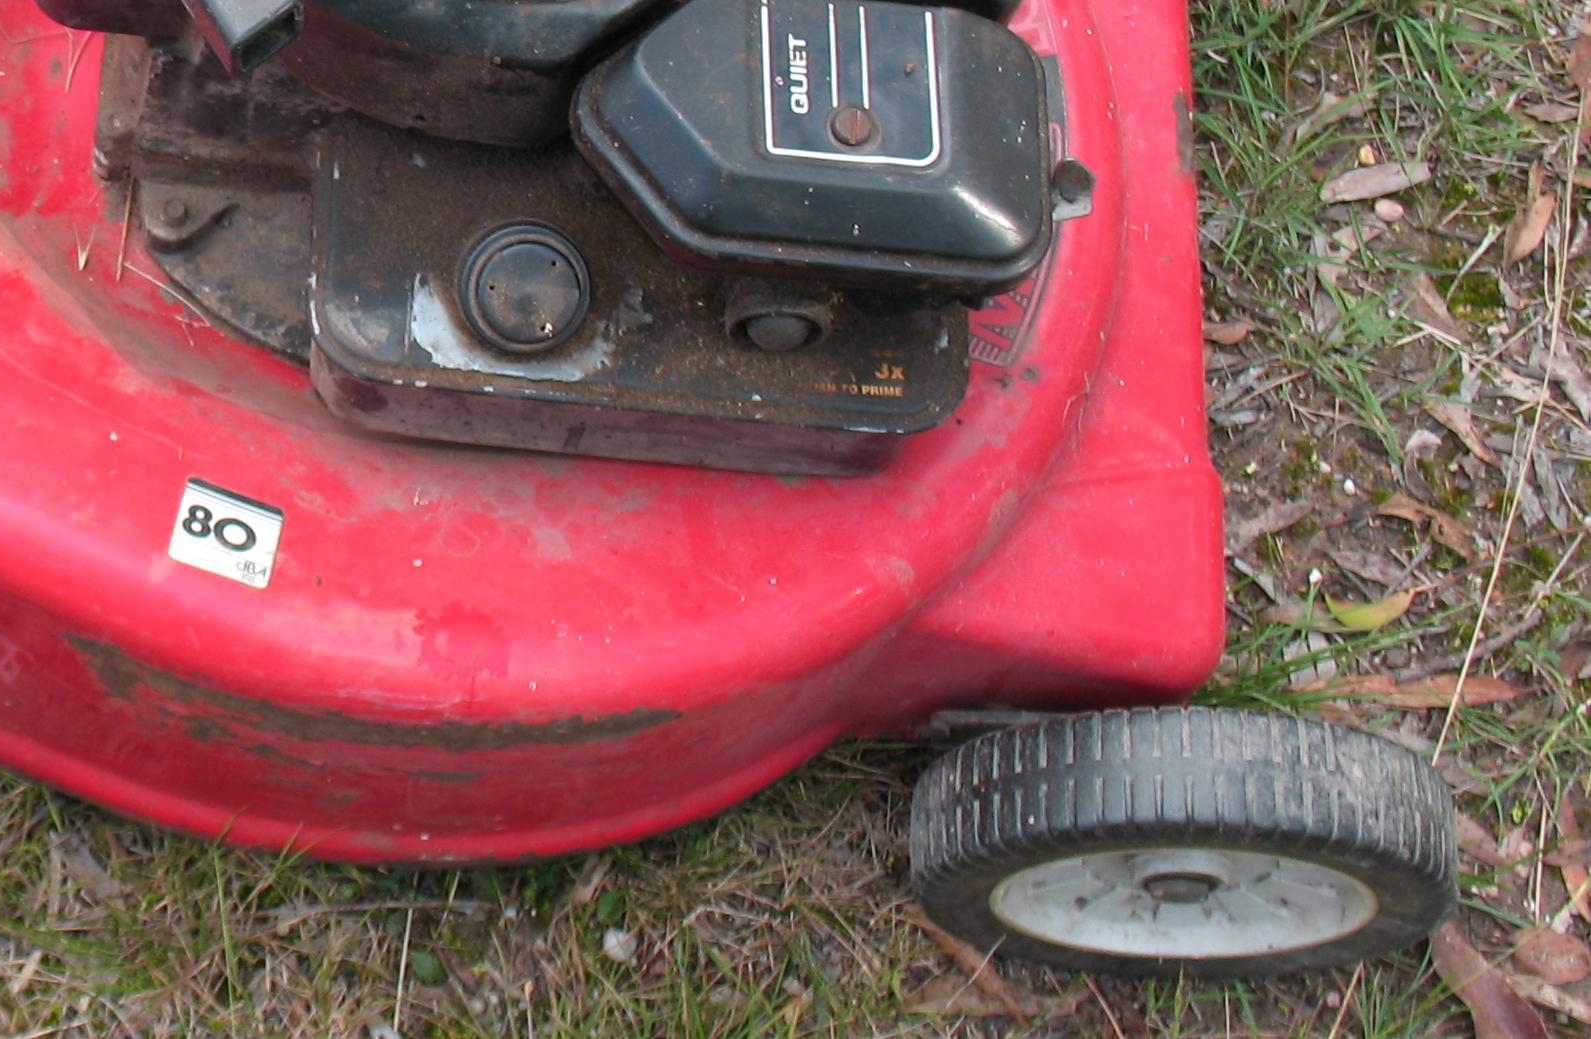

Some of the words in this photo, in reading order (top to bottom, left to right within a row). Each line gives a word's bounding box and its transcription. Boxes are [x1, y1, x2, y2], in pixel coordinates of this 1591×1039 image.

[788, 33, 809, 114] QUIET
[861, 384, 905, 397] PRIME
[182, 504, 257, 552] 80
